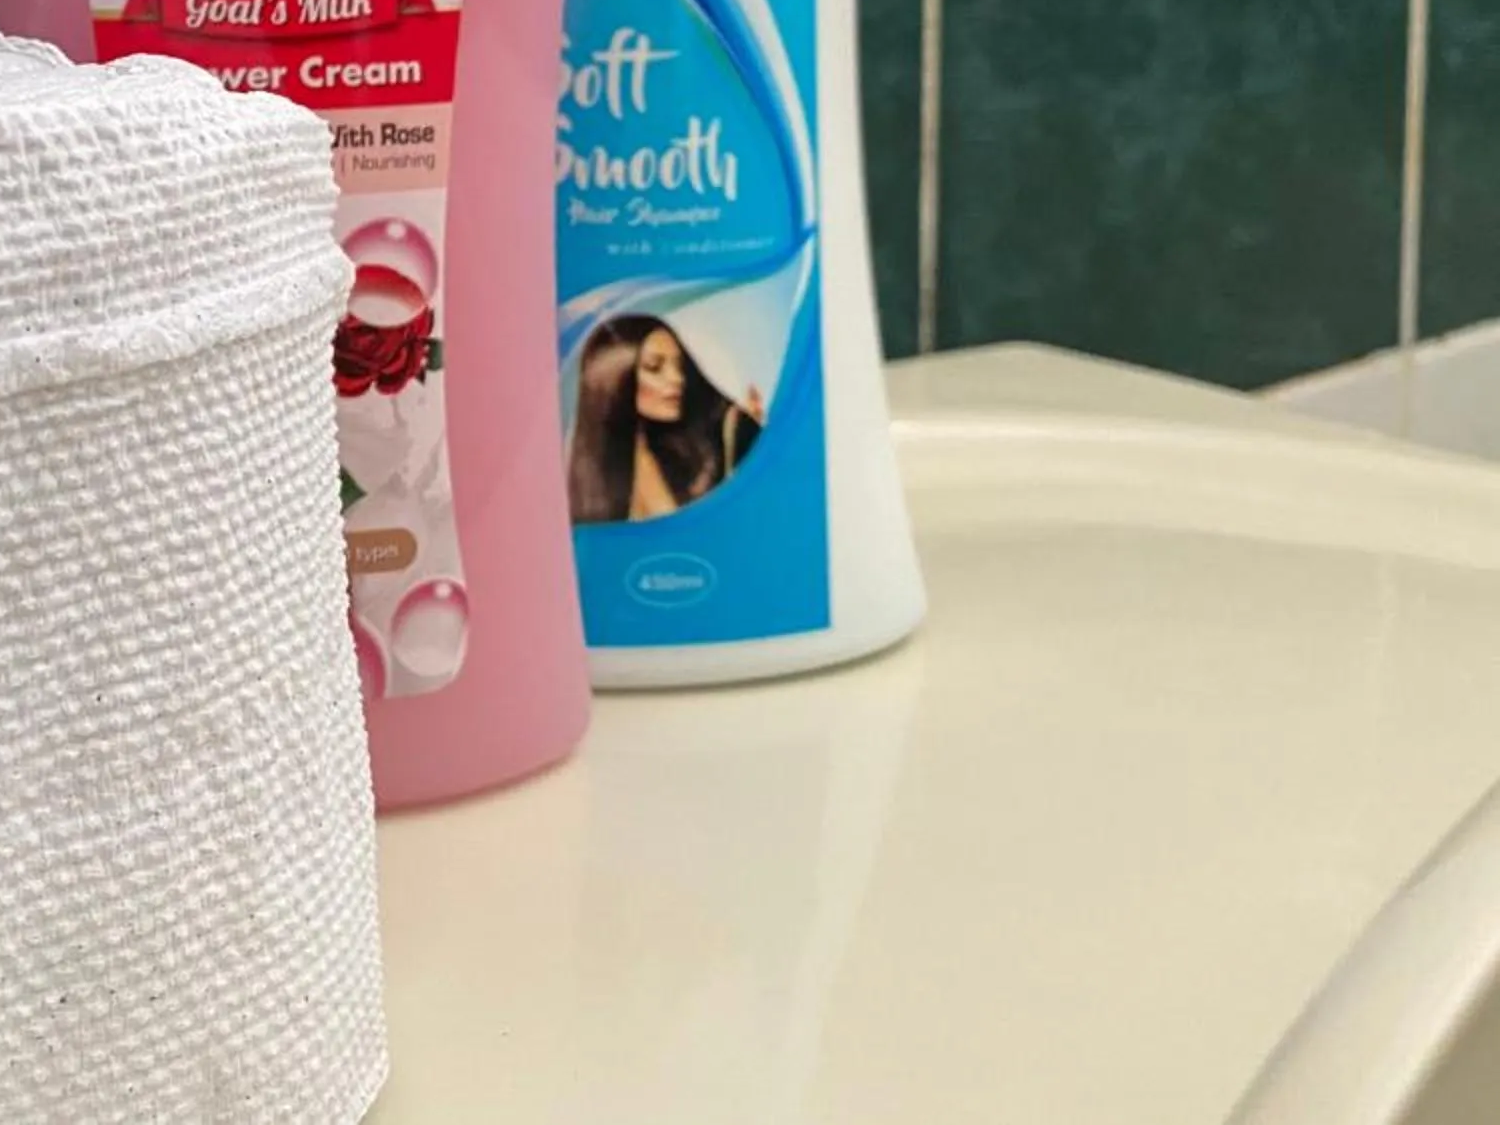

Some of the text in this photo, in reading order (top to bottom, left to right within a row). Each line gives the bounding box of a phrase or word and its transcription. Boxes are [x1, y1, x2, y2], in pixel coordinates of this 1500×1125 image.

[208, 55, 422, 90] wer Cream
[381, 122, 436, 147] Rose
[352, 154, 436, 173] Nourishing
